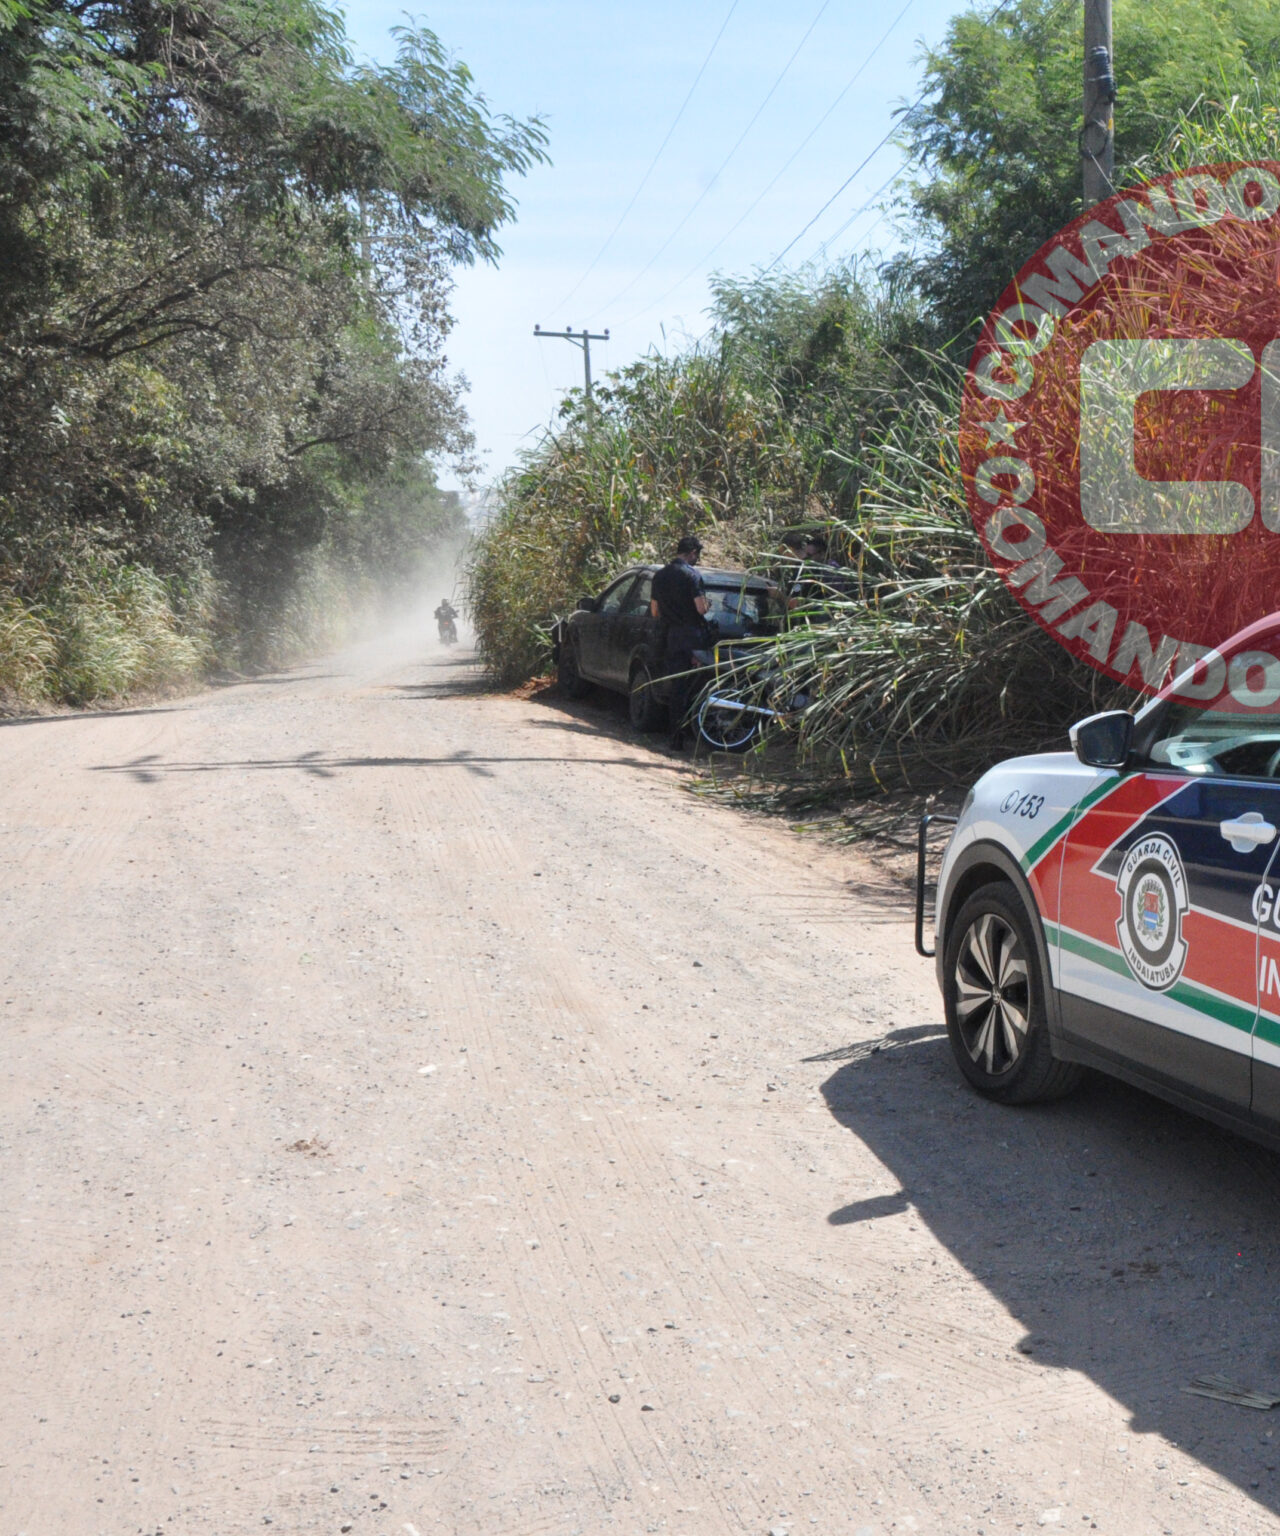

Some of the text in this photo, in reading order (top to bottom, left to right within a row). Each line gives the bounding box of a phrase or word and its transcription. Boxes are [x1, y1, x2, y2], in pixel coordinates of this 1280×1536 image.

[1013, 793, 1045, 819] 153
[1127, 842, 1181, 889] GUARDA CIVIL
[1128, 947, 1175, 983] INDAIATUBA
